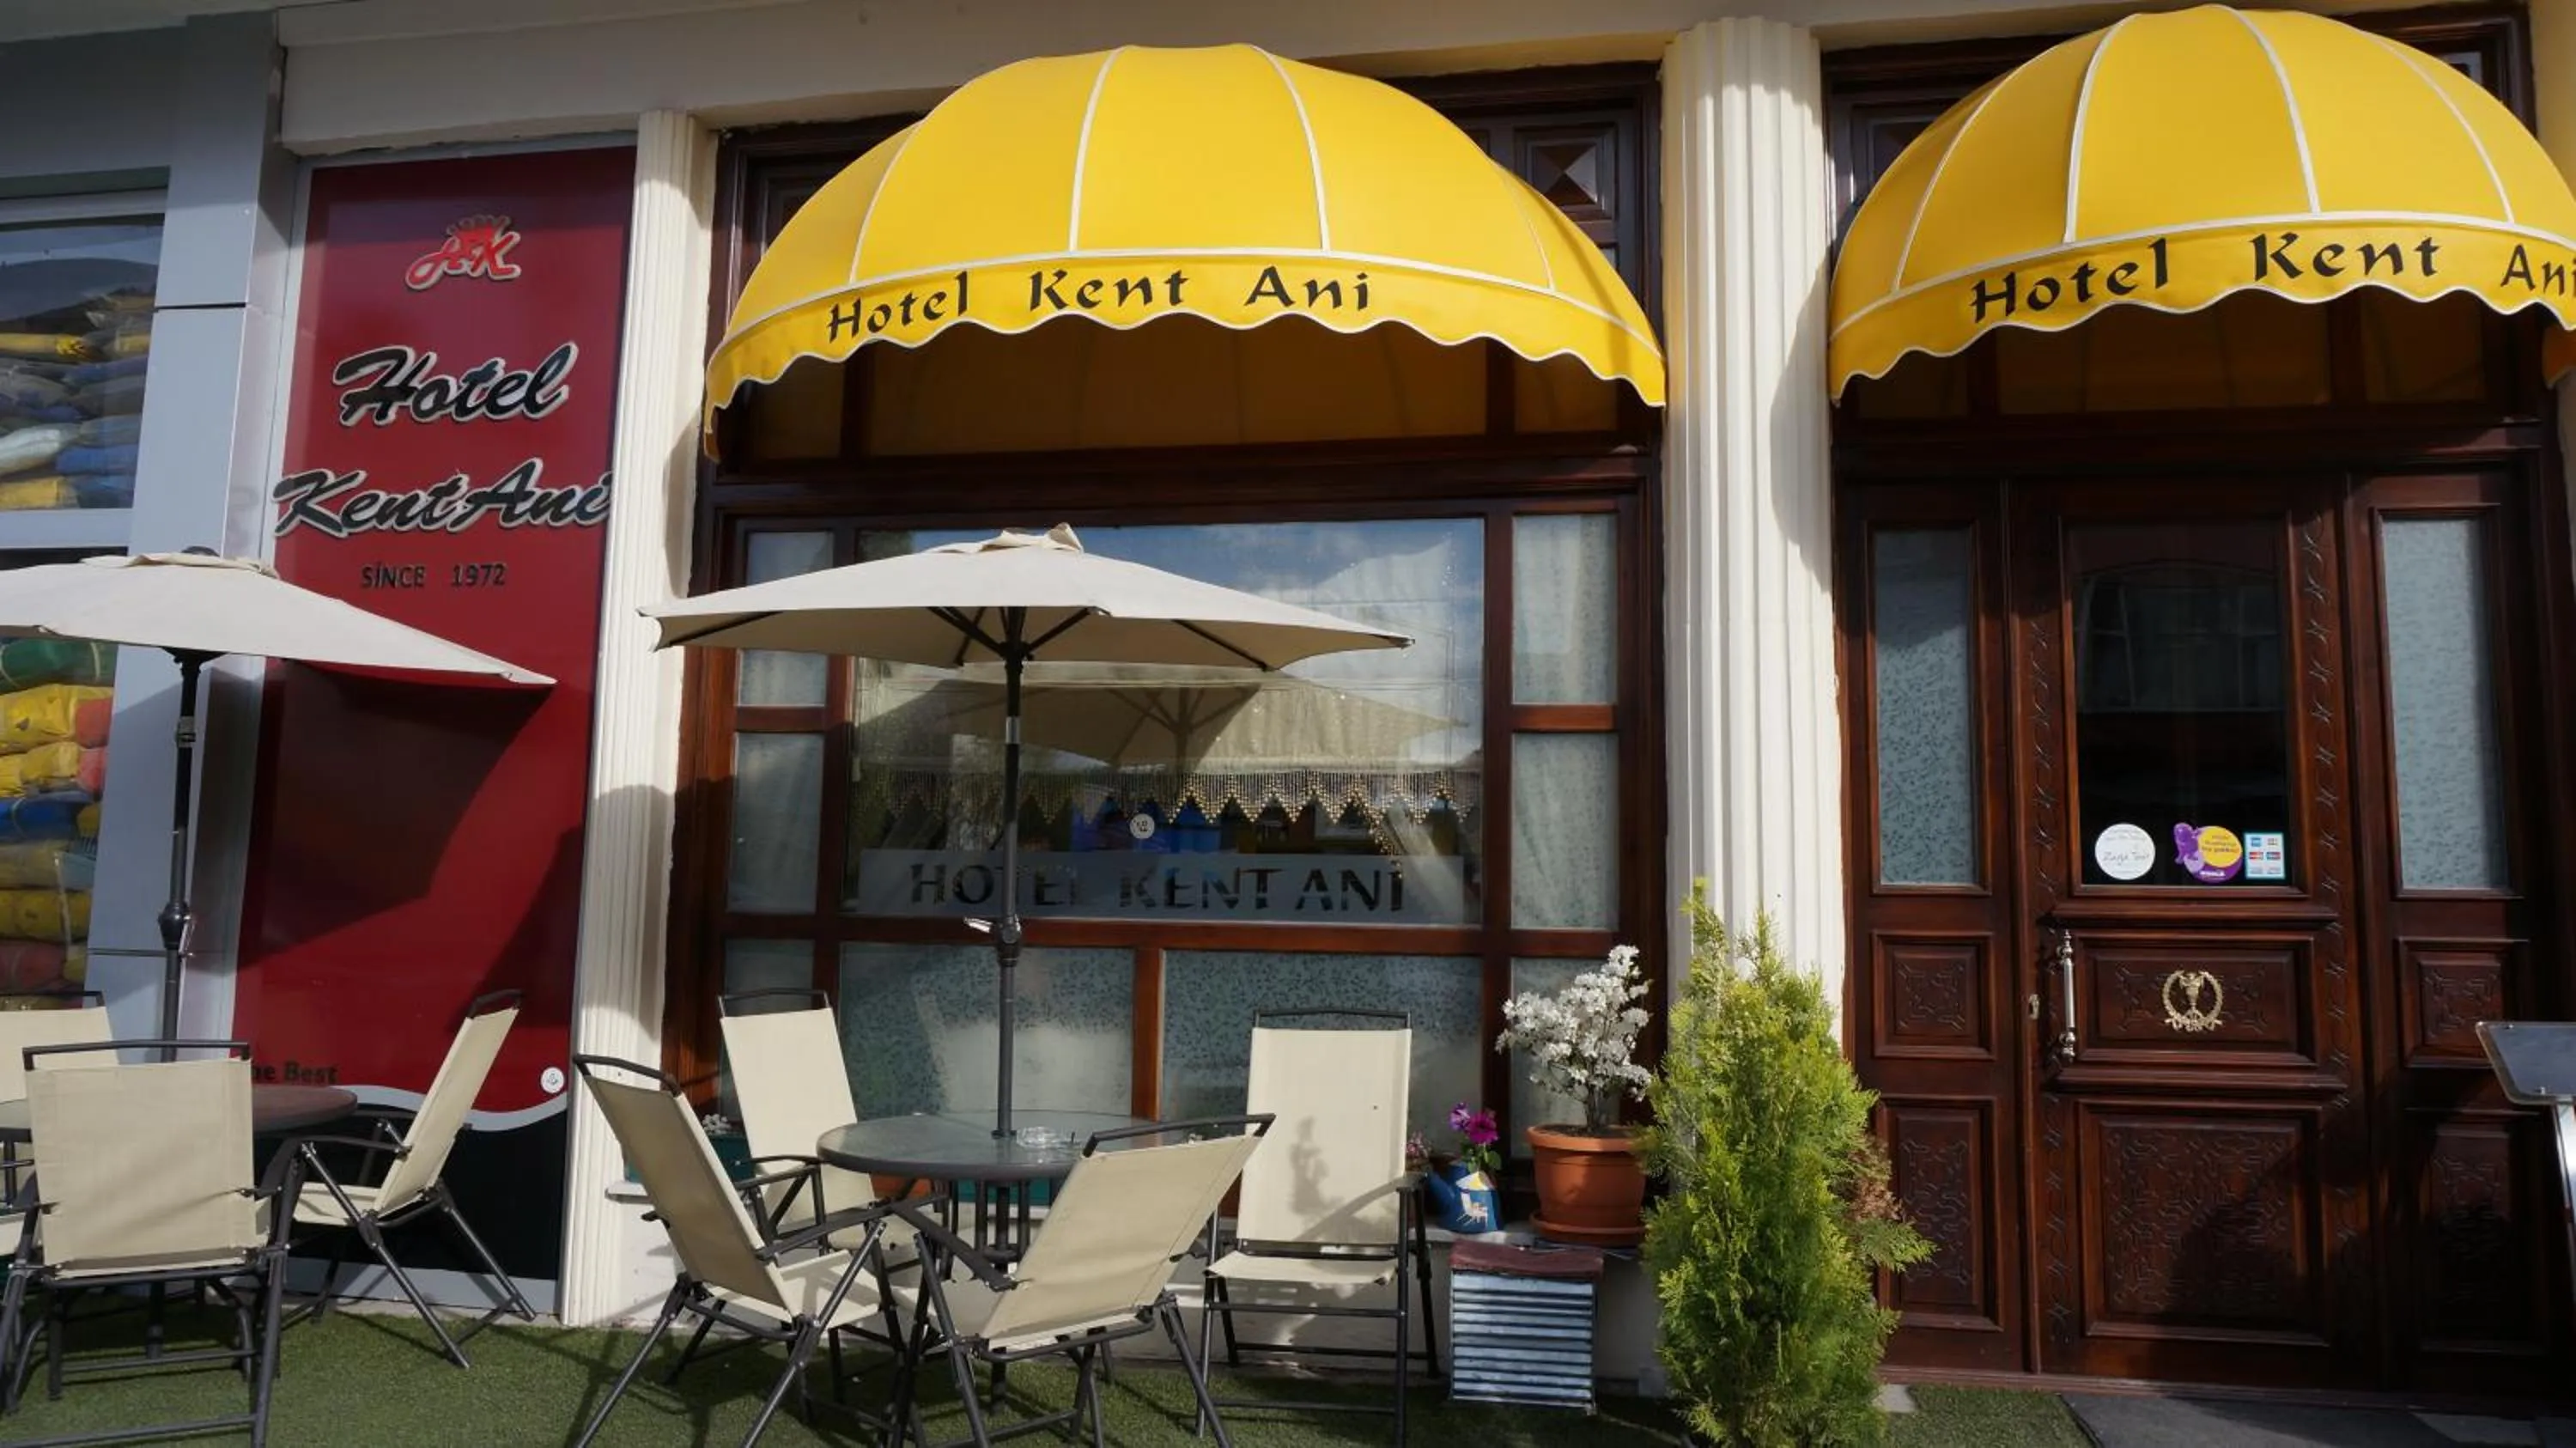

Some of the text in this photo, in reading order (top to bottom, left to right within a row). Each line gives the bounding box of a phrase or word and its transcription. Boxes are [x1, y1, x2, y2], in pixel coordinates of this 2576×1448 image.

[828, 265, 1370, 343] Hotel Kent Ani
[1970, 232, 2576, 323] Hotel Kent Ani
[333, 341, 579, 427] Hotel
[451, 563, 507, 588] 1972
[1118, 867, 1282, 910] KENT
[251, 1060, 339, 1083] he Best
